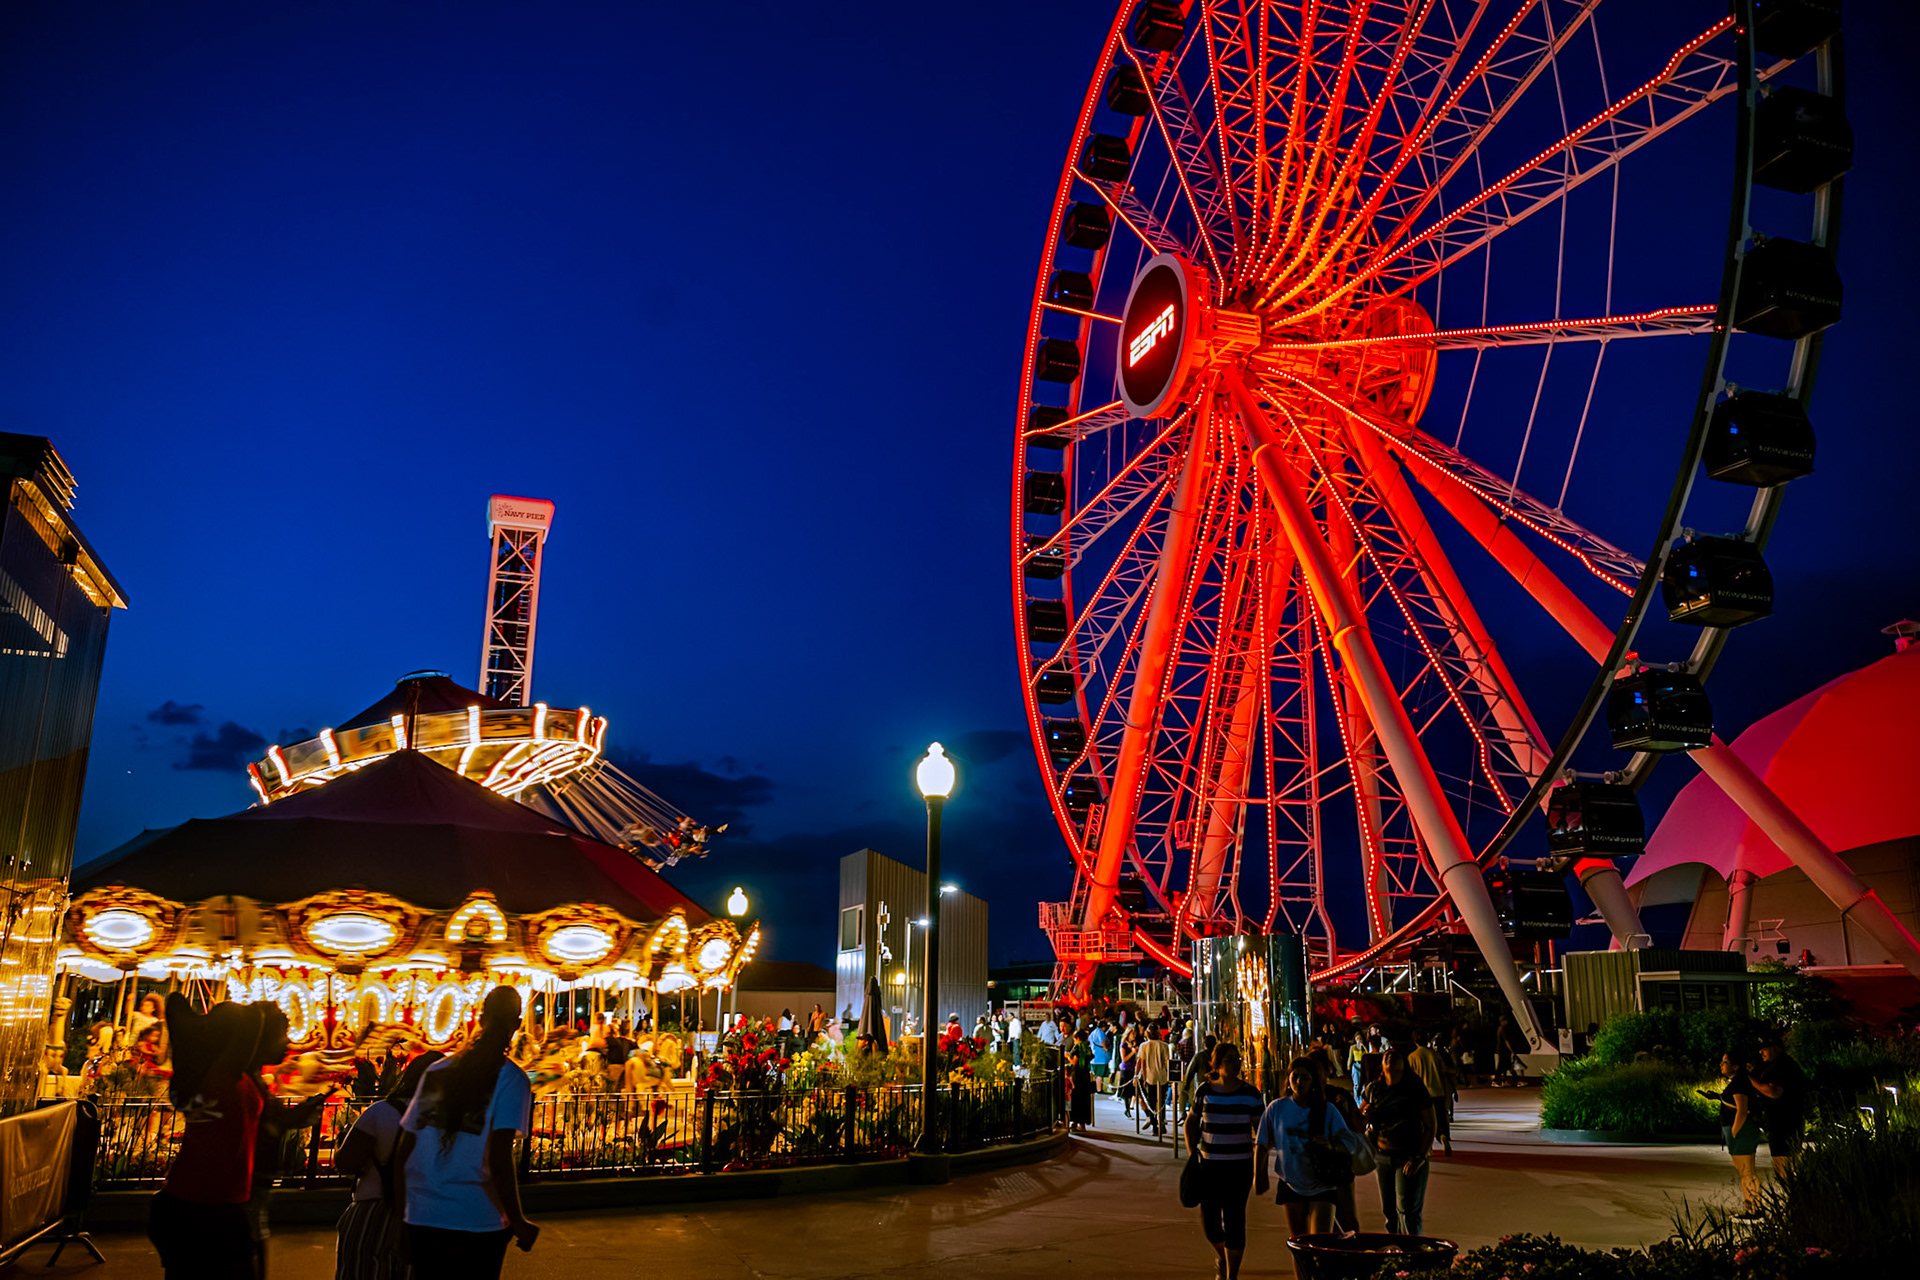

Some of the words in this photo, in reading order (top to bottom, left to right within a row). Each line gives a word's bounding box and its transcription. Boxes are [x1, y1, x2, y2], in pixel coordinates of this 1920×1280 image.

[1130, 304, 1174, 368] ESPN
[504, 510, 525, 518] NAVY
[526, 512, 546, 520] PIER
